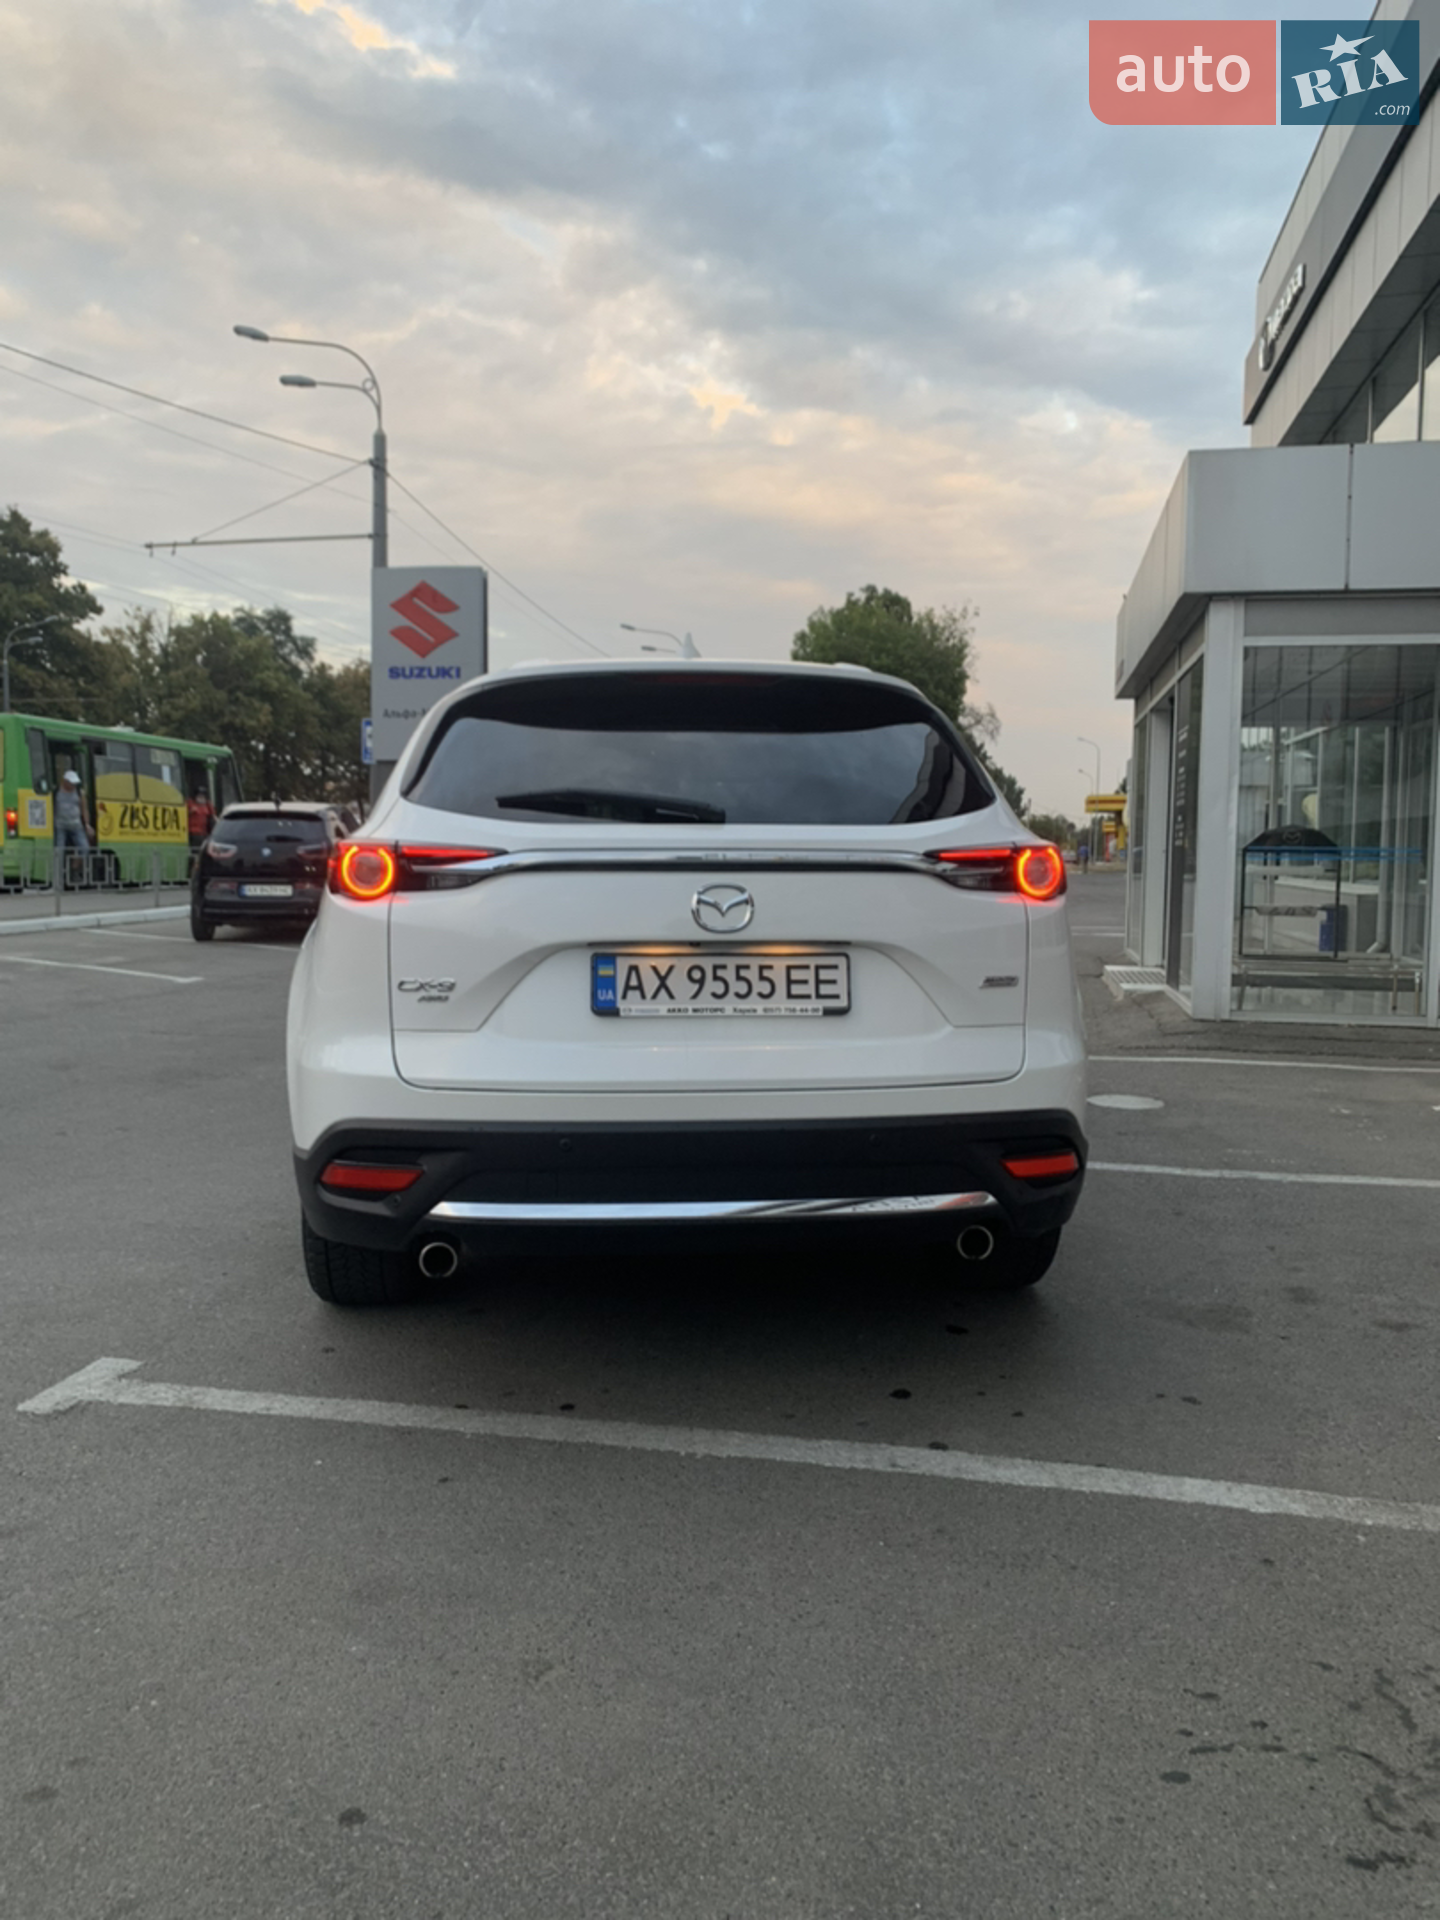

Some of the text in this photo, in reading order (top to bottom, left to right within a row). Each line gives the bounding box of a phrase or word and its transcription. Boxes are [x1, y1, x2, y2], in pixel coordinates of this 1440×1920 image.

[388, 665, 462, 680] SUZUKI
[397, 977, 456, 993] CX-9
[621, 964, 841, 1000] AX 9555 EE
[597, 988, 615, 1000] UA
